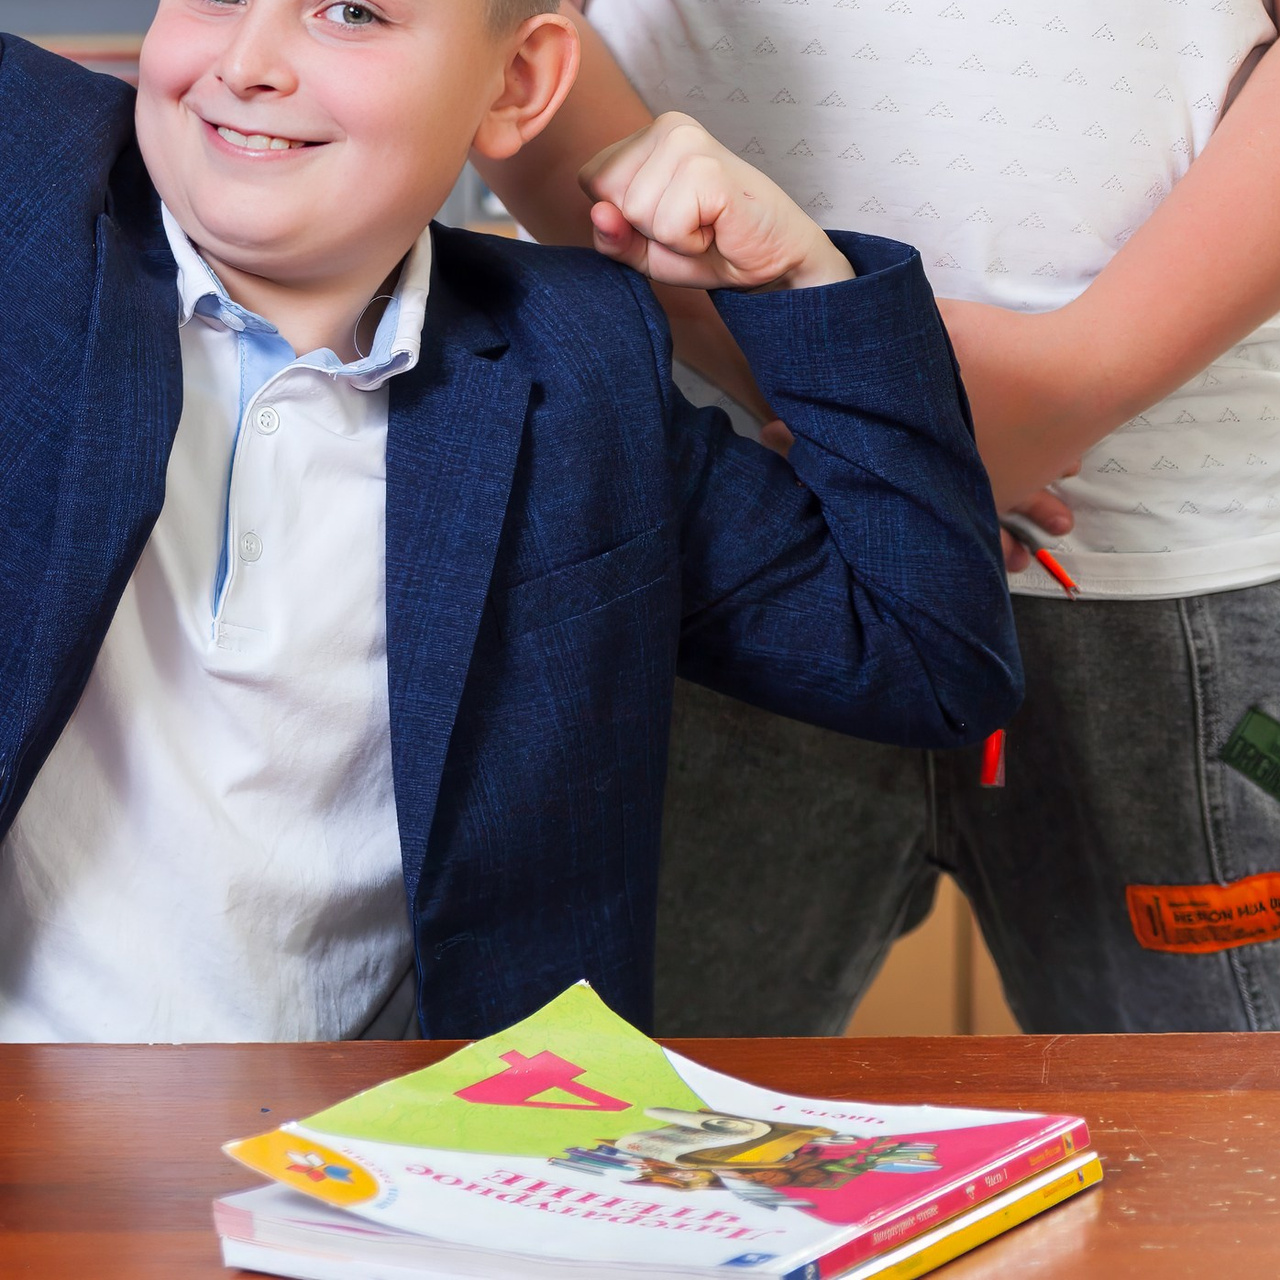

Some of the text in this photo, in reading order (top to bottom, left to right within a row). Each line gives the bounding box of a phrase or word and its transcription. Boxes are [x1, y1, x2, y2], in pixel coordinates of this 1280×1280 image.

[453, 1049, 633, 1112] 4
[800, 1109, 885, 1124] Часть
[404, 1164, 785, 1241] Литературное
[482, 1169, 741, 1223] ЧТЕНИЕ
